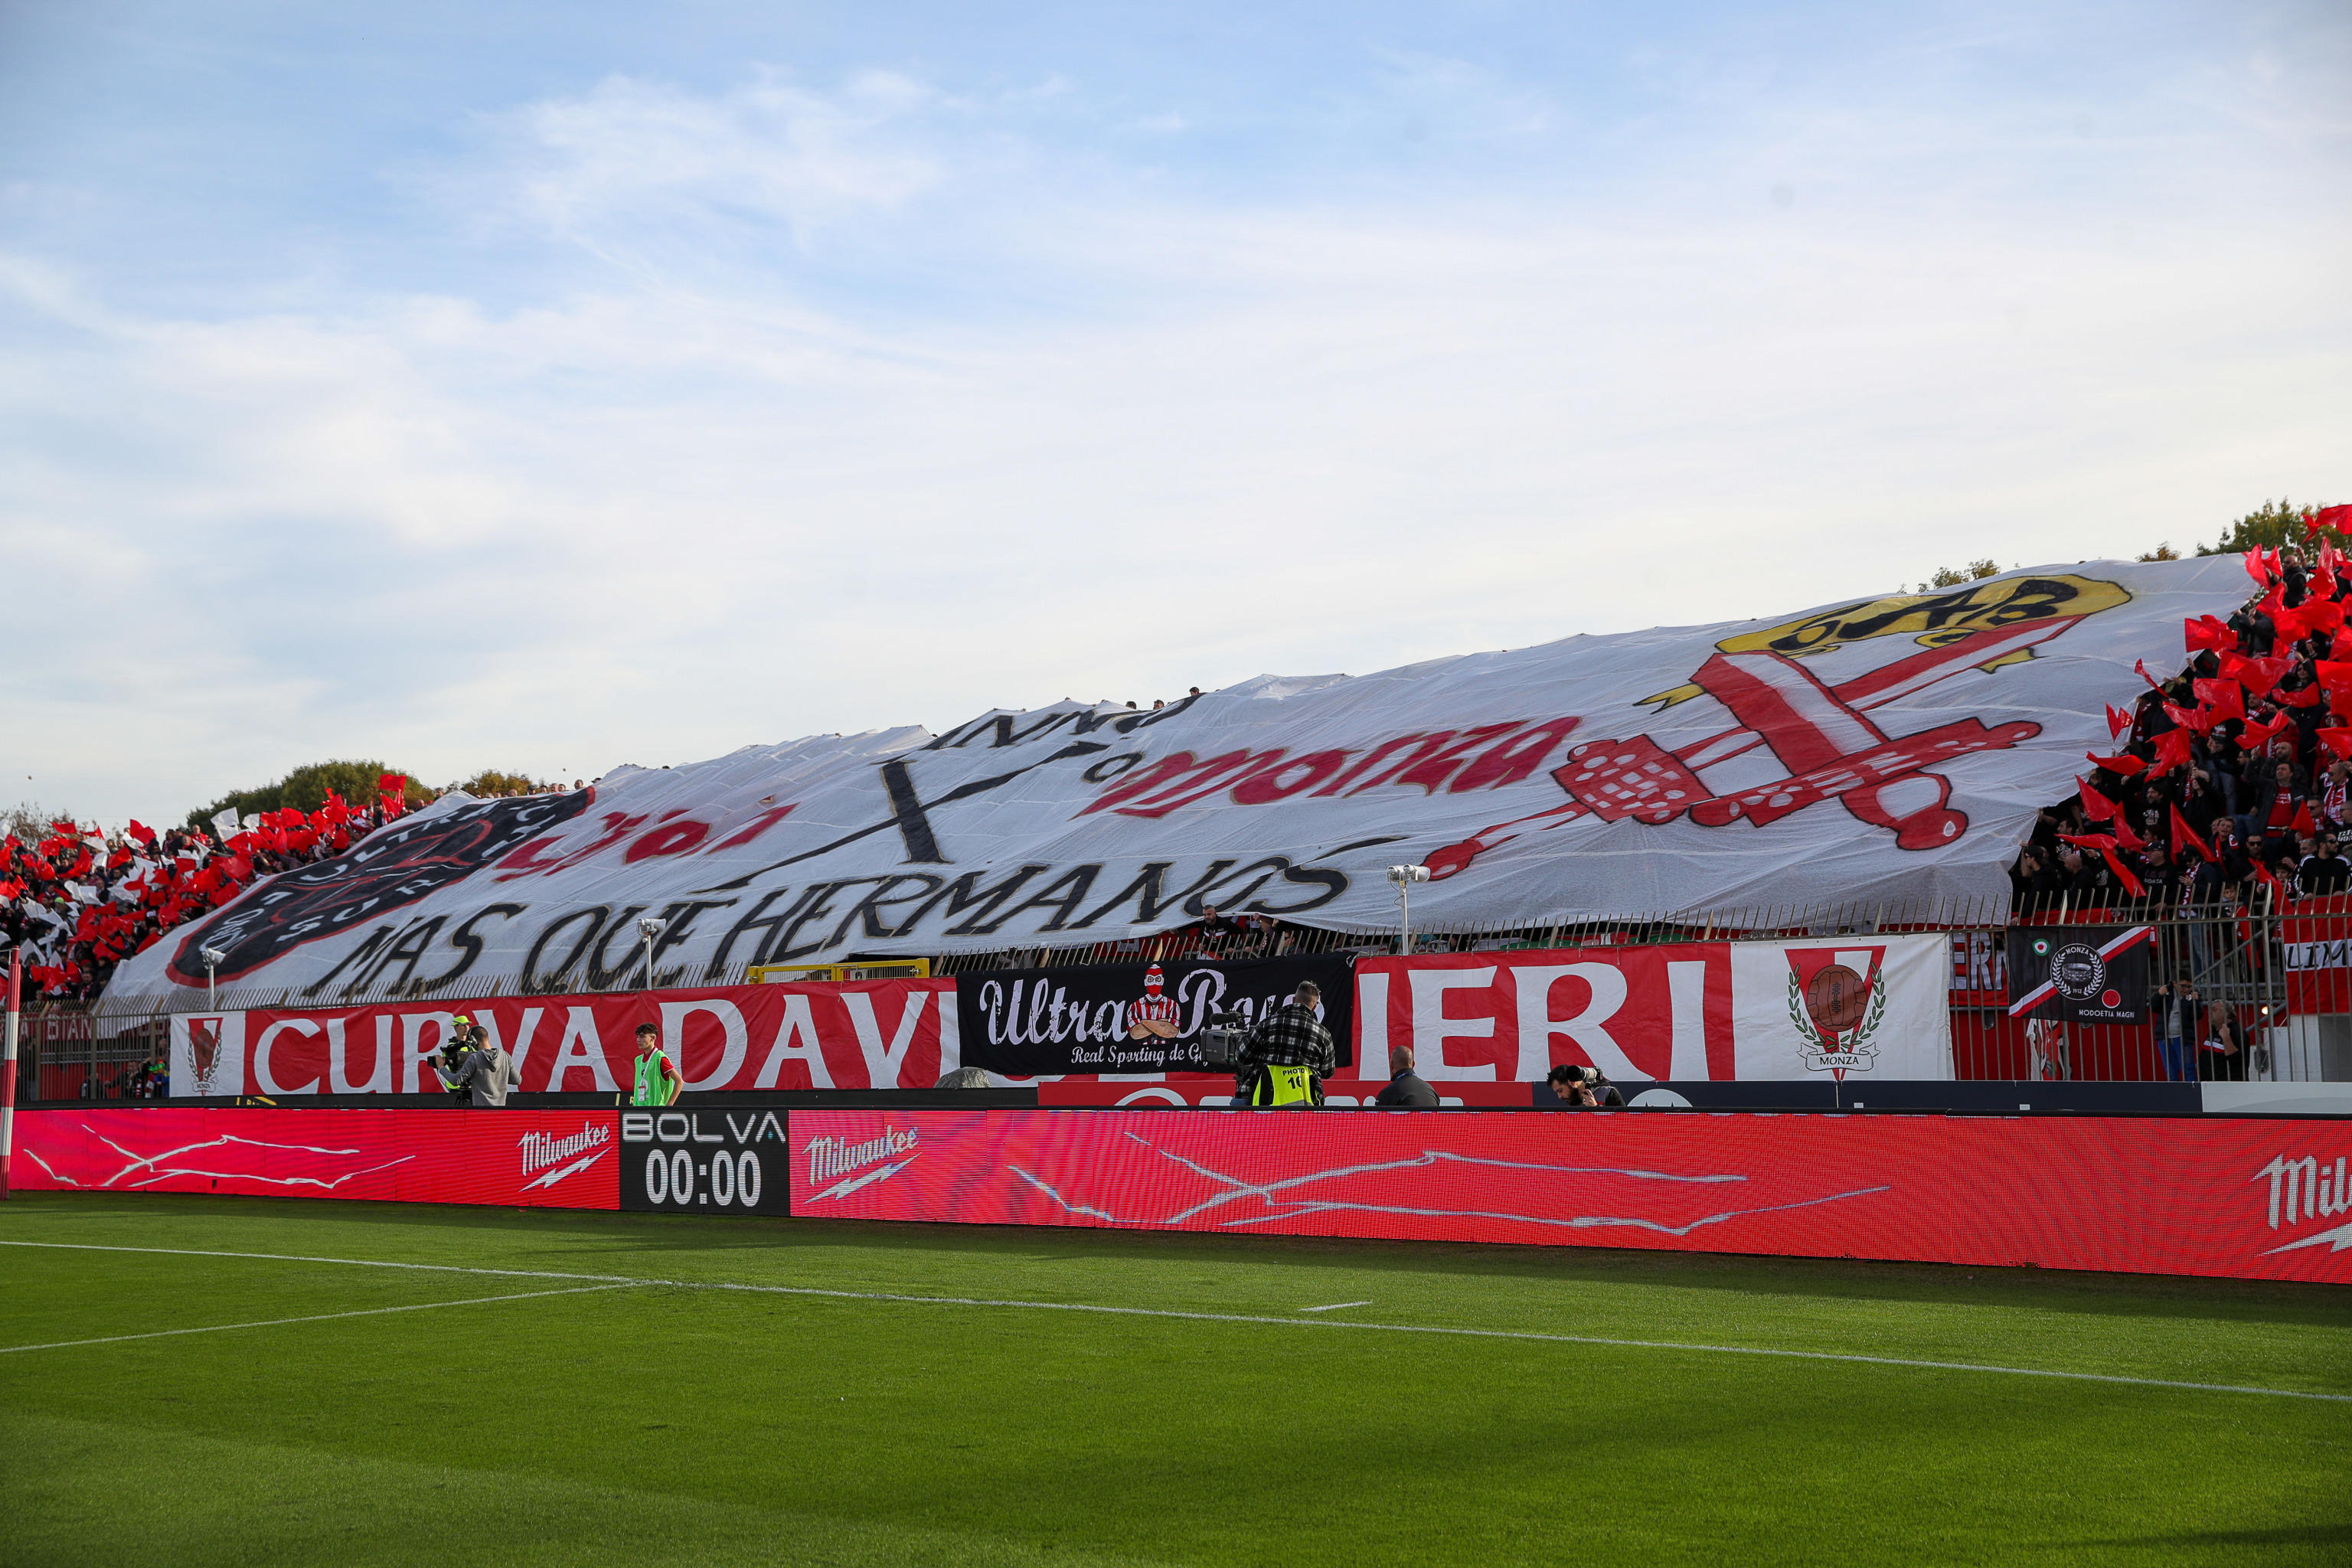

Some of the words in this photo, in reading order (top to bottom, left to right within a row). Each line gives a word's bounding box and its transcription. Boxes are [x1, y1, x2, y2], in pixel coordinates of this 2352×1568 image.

[1067, 715, 1582, 822] Monza
[702, 836, 1411, 982] HERMANOS
[305, 902, 529, 996] MAS
[2065, 946, 2090, 956] MONZA
[2287, 942, 2352, 970] LIM
[253, 1005, 621, 1096] CURVA
[1358, 959, 1707, 1082] IERI
[979, 978, 1132, 1046] Ultra
[2078, 1008, 2115, 1018] MODOETIA
[1071, 1045, 1105, 1064] Real
[1106, 1043, 1165, 1067] Sporting
[1168, 1044, 1185, 1062] de
[1282, 1066, 1306, 1077] PHOTO
[1819, 1056, 1859, 1067] MONZA
[516, 1121, 611, 1177] Milwaukee
[622, 1112, 786, 1145] BOLVA
[802, 1125, 920, 1187] Milwaukee
[645, 1148, 761, 1207] 00:00
[2249, 1153, 2352, 1230] Mil
